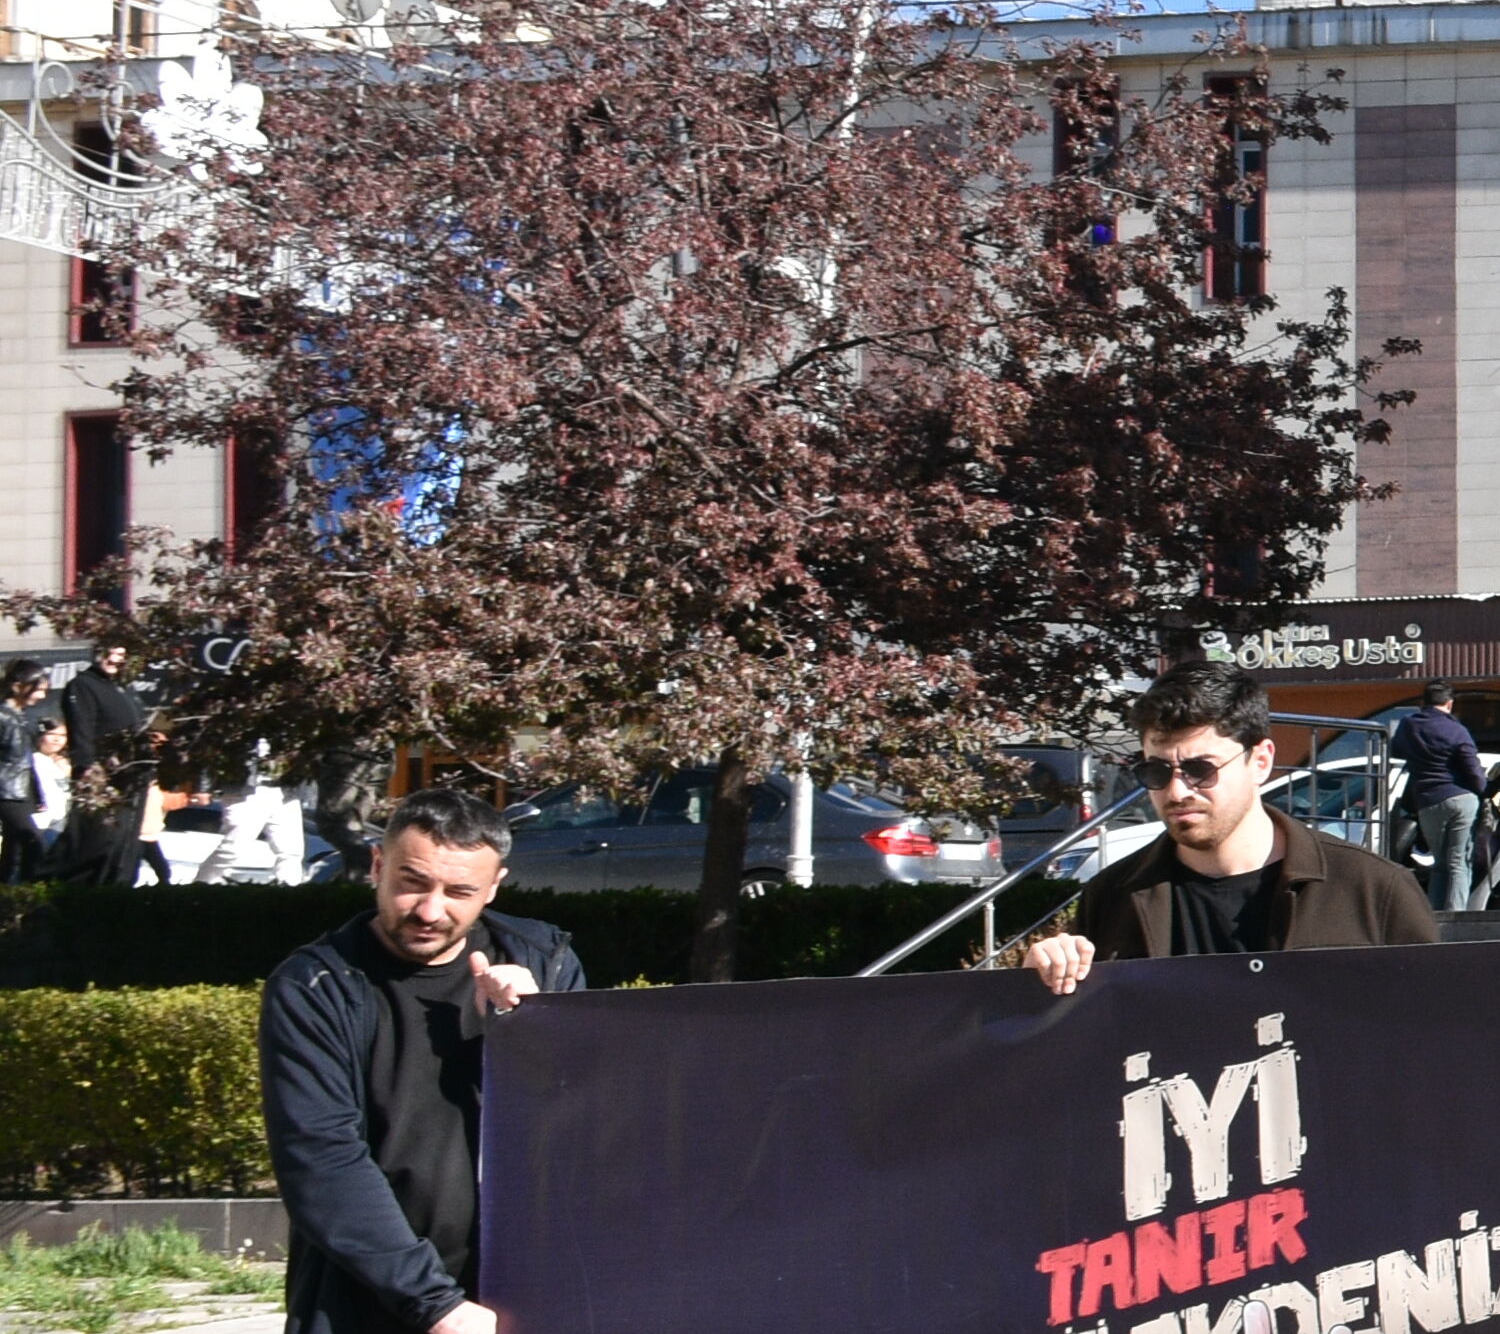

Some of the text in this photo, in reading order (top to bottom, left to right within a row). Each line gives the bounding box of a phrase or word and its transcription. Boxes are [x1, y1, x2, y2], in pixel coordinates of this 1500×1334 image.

[1236, 628, 1340, 670] Ökkeş
[1343, 635, 1424, 666] Usta
[1119, 1012, 1307, 1221] İYİ
[1035, 1187, 1308, 1327] TANIR
